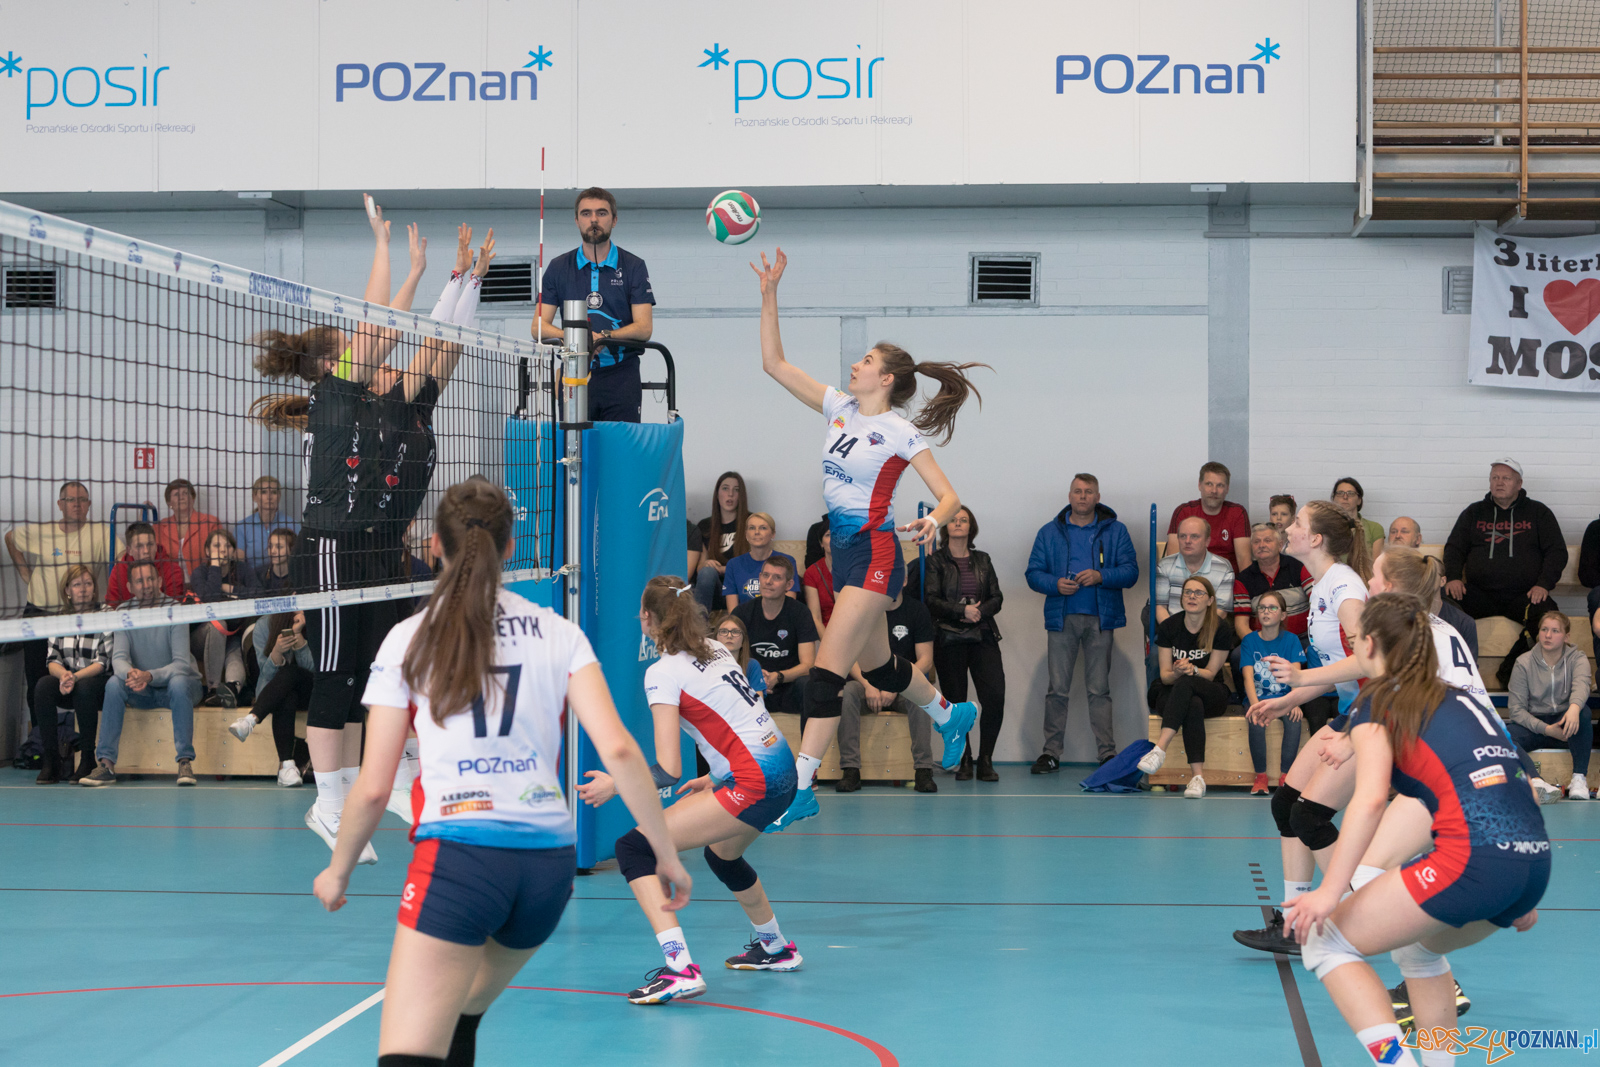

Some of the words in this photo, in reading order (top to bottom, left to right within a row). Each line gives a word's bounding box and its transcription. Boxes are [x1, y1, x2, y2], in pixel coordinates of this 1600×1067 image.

[26, 53, 170, 121] posir
[734, 44, 885, 114] posir
[26, 123, 78, 134] Poznańskie
[80, 123, 116, 133] Ośrodki
[118, 123, 149, 134] Sportu
[155, 123, 196, 134] Rekreacji
[734, 117, 790, 127] Poznańskie
[792, 116, 829, 126] Ośrodki
[831, 116, 863, 126] Sportu
[870, 115, 913, 126] Rekreacji
[1493, 238, 1520, 267] 3
[1509, 285, 1529, 319] I
[828, 433, 859, 459] 14
[824, 465, 853, 484] Enea
[1450, 635, 1474, 676] 4
